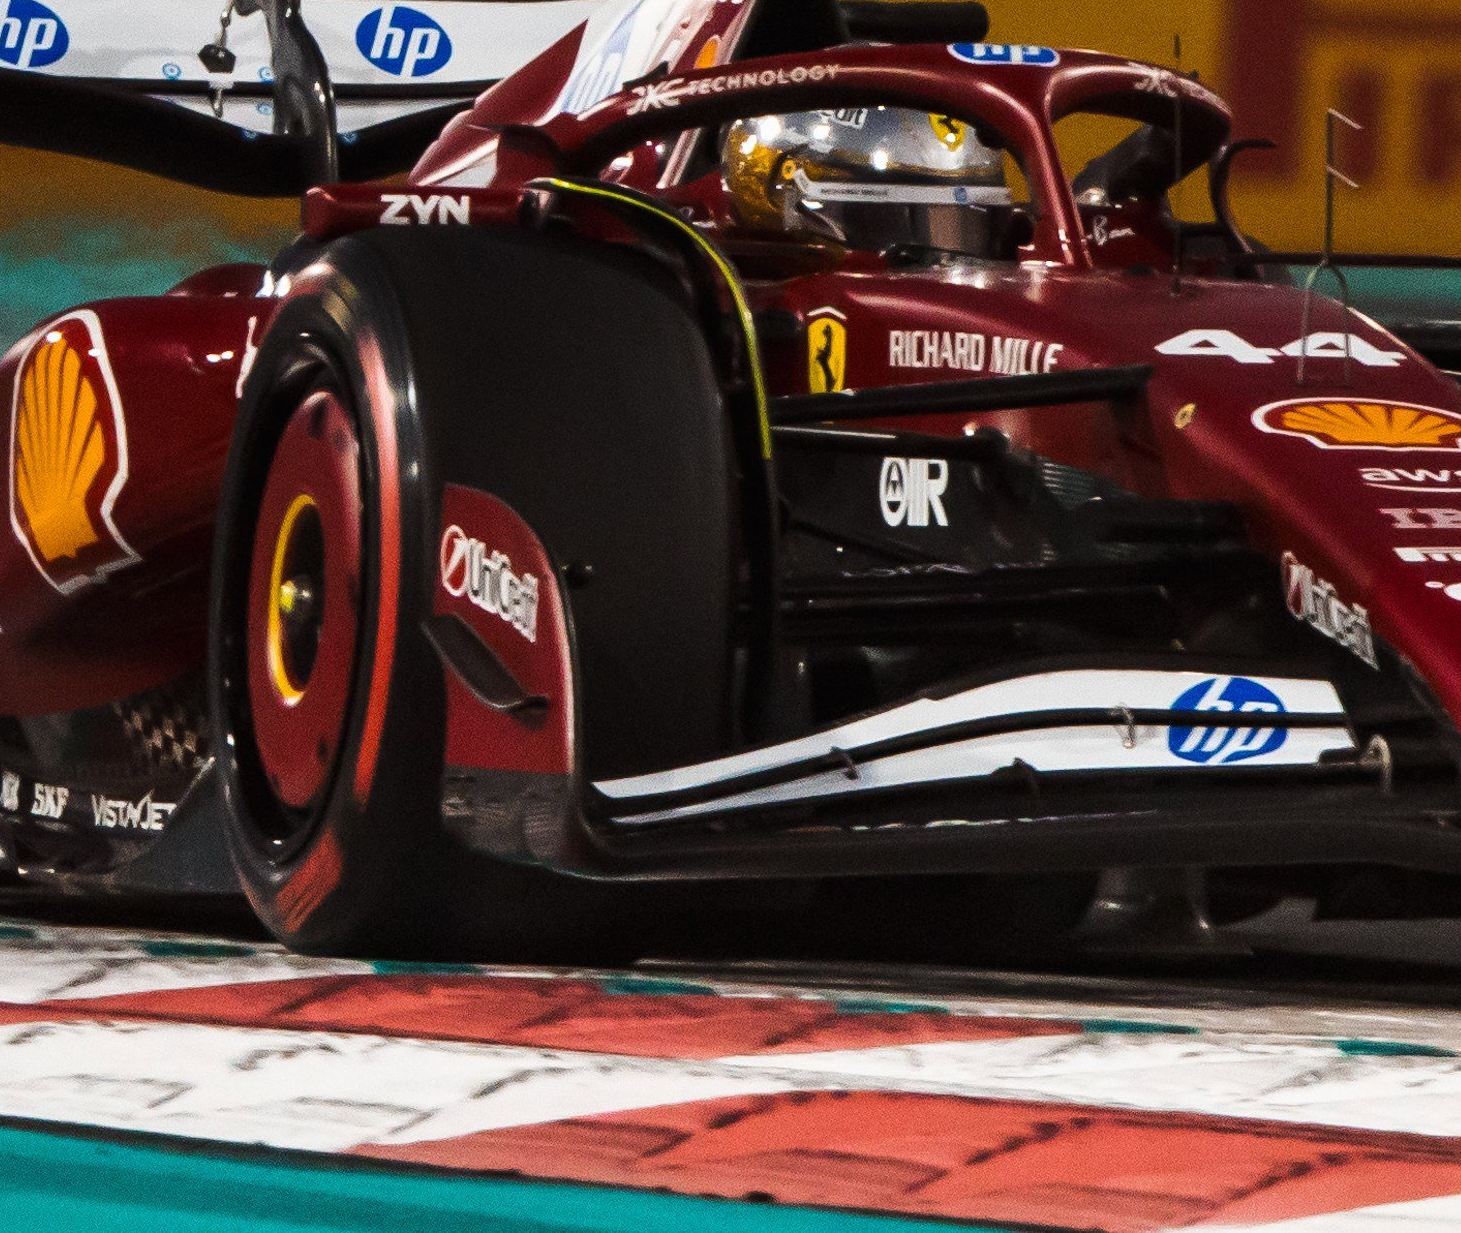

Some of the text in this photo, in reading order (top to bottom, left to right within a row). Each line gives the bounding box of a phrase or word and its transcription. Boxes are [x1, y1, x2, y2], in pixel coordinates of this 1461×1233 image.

[370, 7, 441, 76] hp
[687, 64, 840, 96] TECHNOLOGY
[379, 194, 470, 225] ZYN
[888, 329, 985, 372] RICHARD
[1153, 329, 1407, 366] 44
[1175, 677, 1277, 763] hp
[31, 782, 70, 819] SKF
